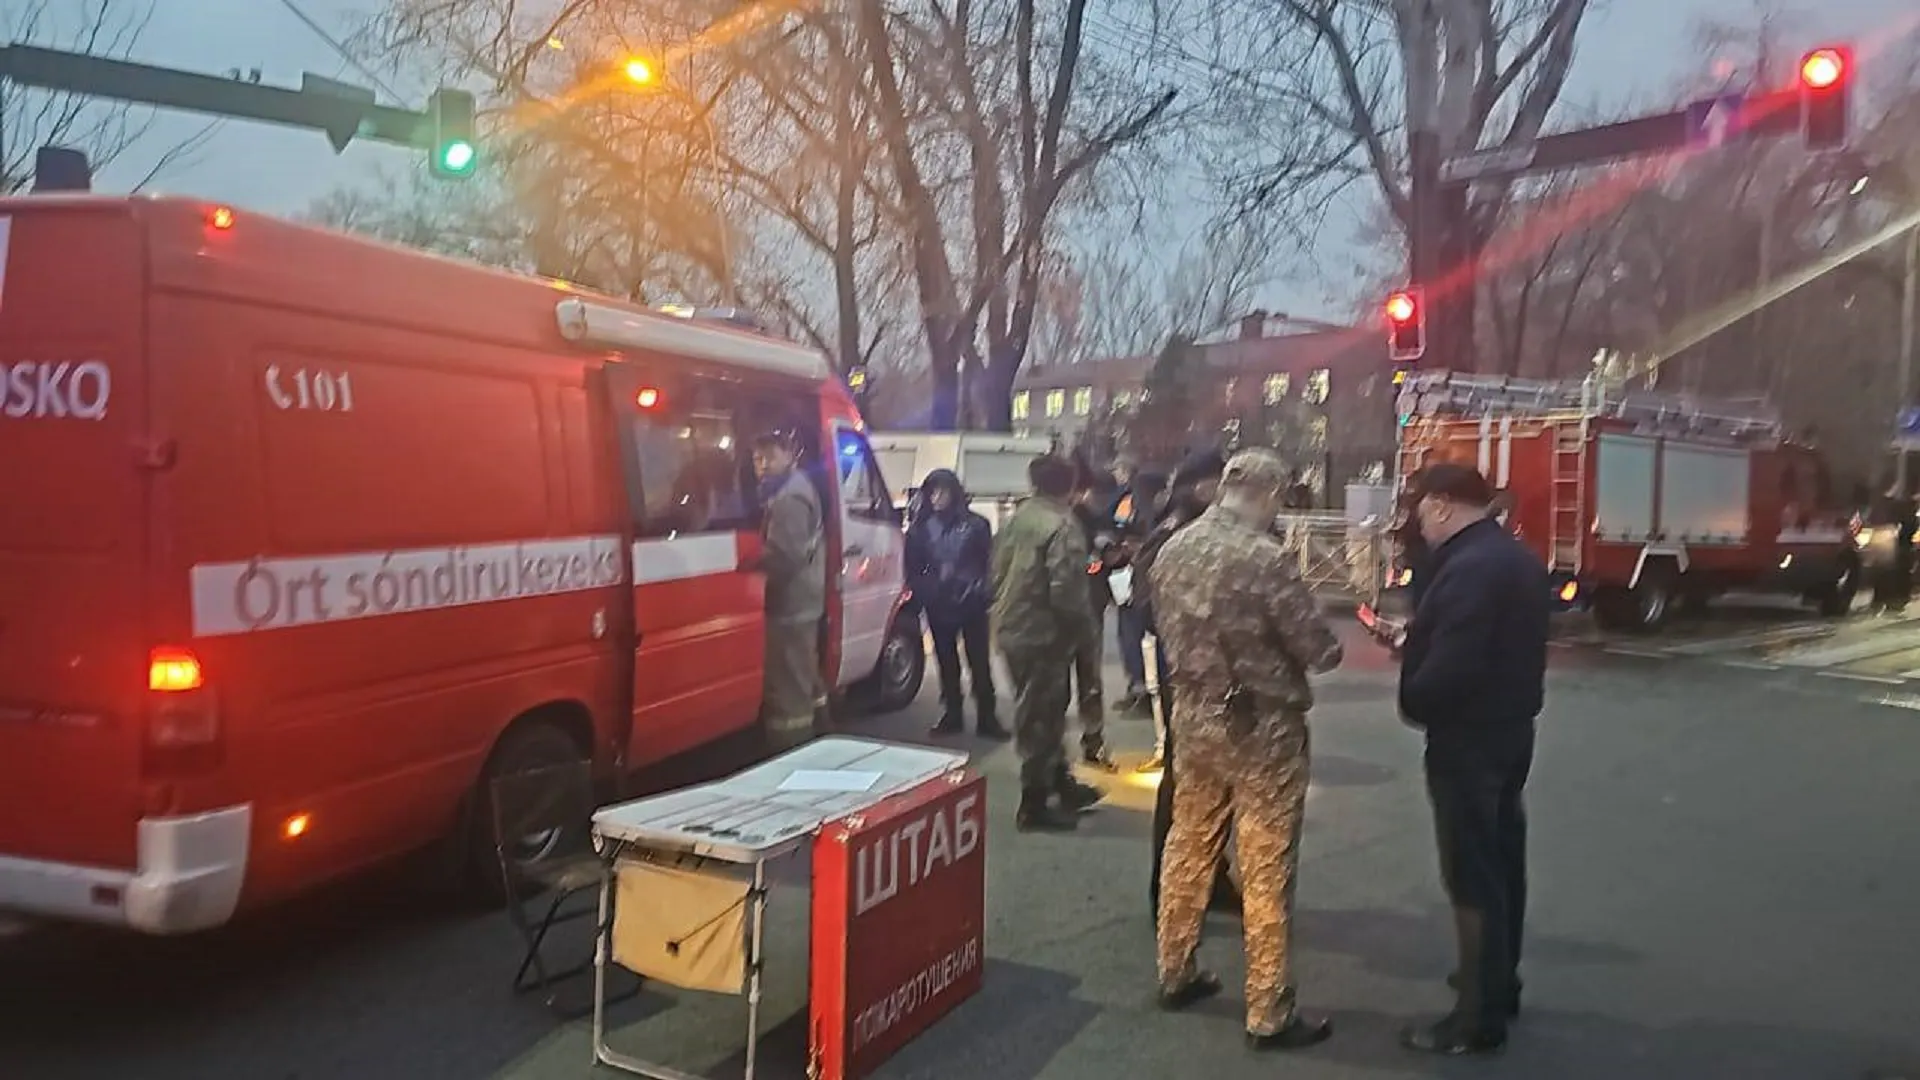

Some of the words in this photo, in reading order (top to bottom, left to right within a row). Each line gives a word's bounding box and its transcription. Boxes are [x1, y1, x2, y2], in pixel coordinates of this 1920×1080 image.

[292, 367, 353, 411] 101
[856, 791, 979, 916] ШТАБ
[853, 936, 977, 1054] ПОЖАРОТУШЕНИЯ
